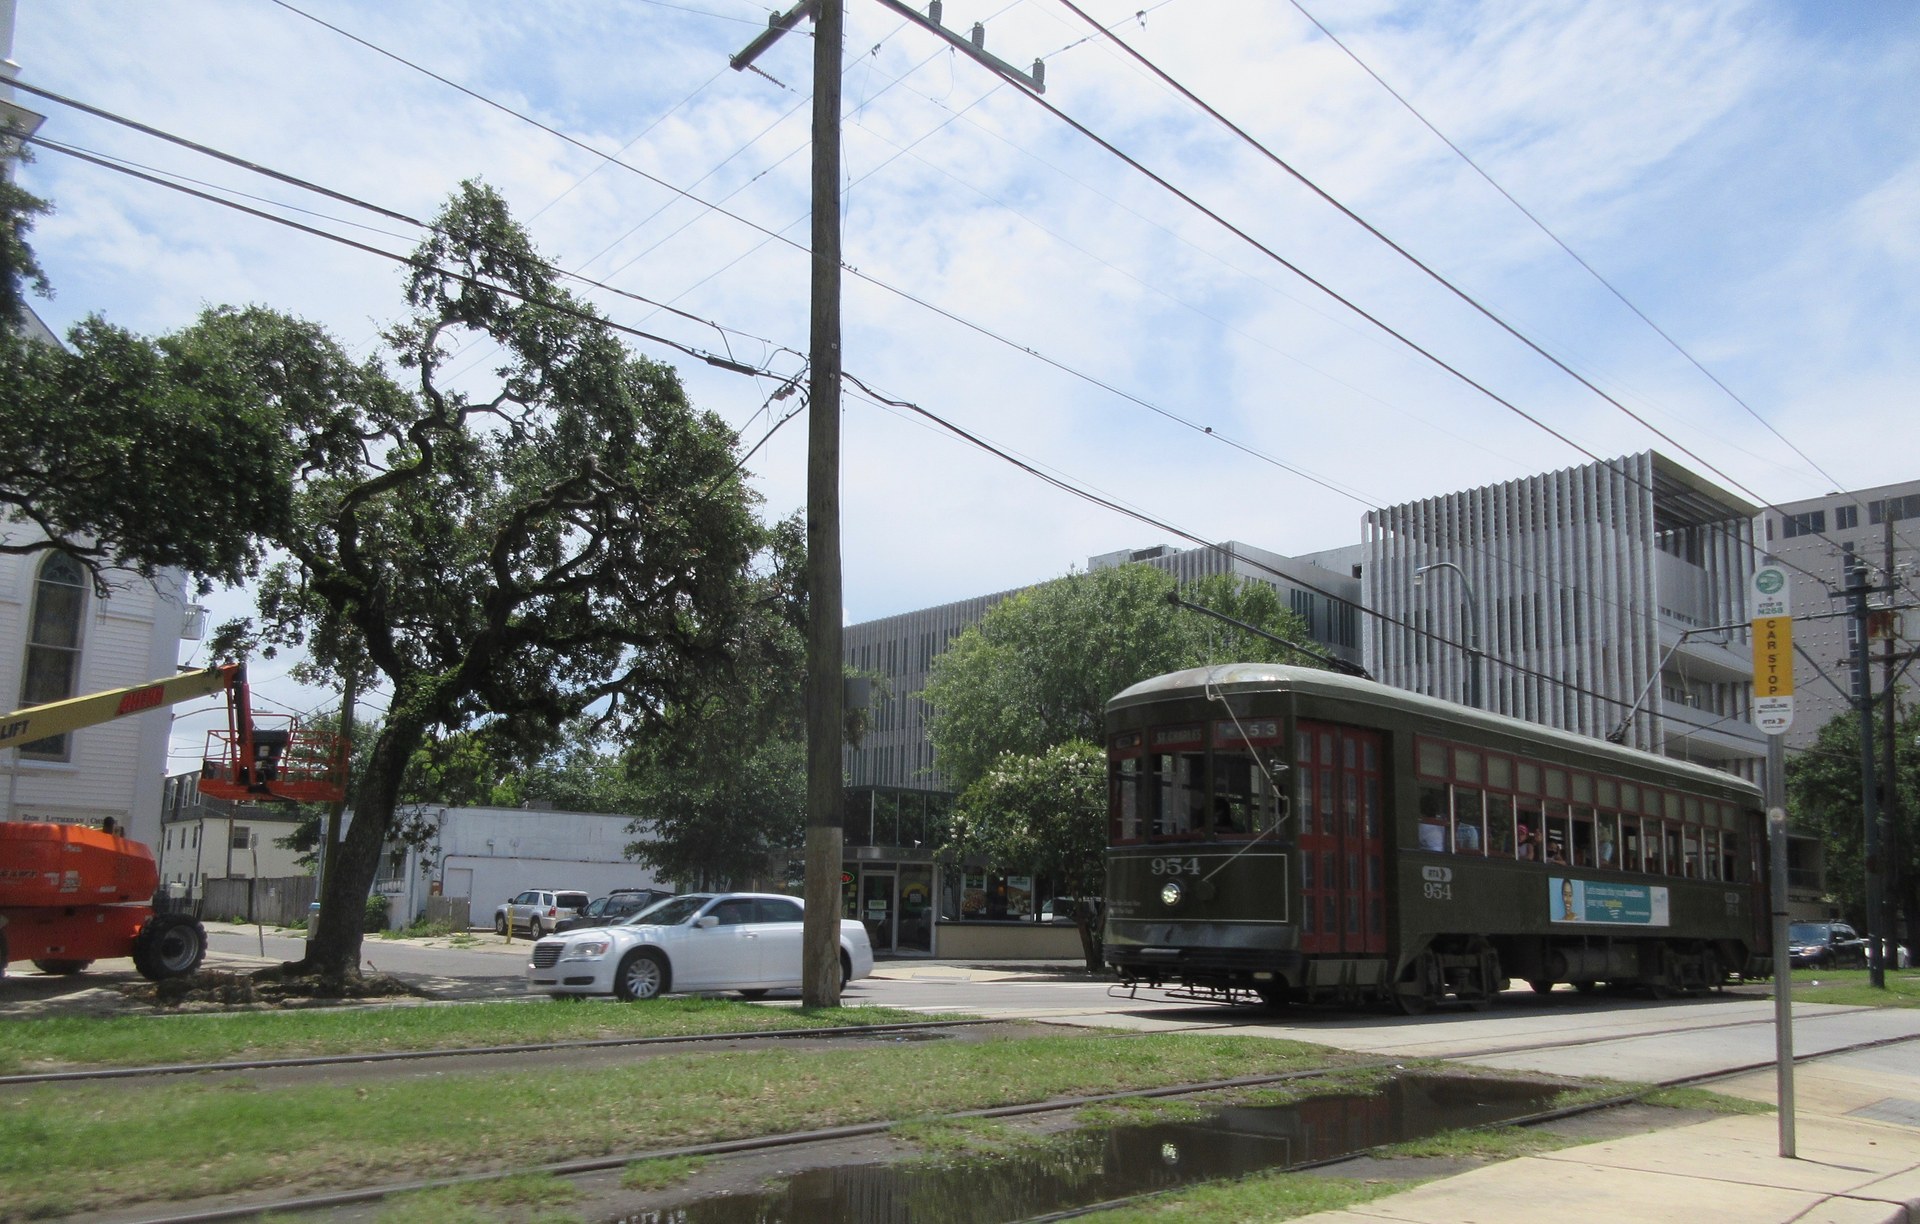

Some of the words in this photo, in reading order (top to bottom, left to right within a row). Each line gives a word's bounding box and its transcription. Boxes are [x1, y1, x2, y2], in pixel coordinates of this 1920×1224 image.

[0, 719, 31, 740] LIFT
[1151, 857, 1201, 876] 954
[1423, 882, 1453, 900] 954
